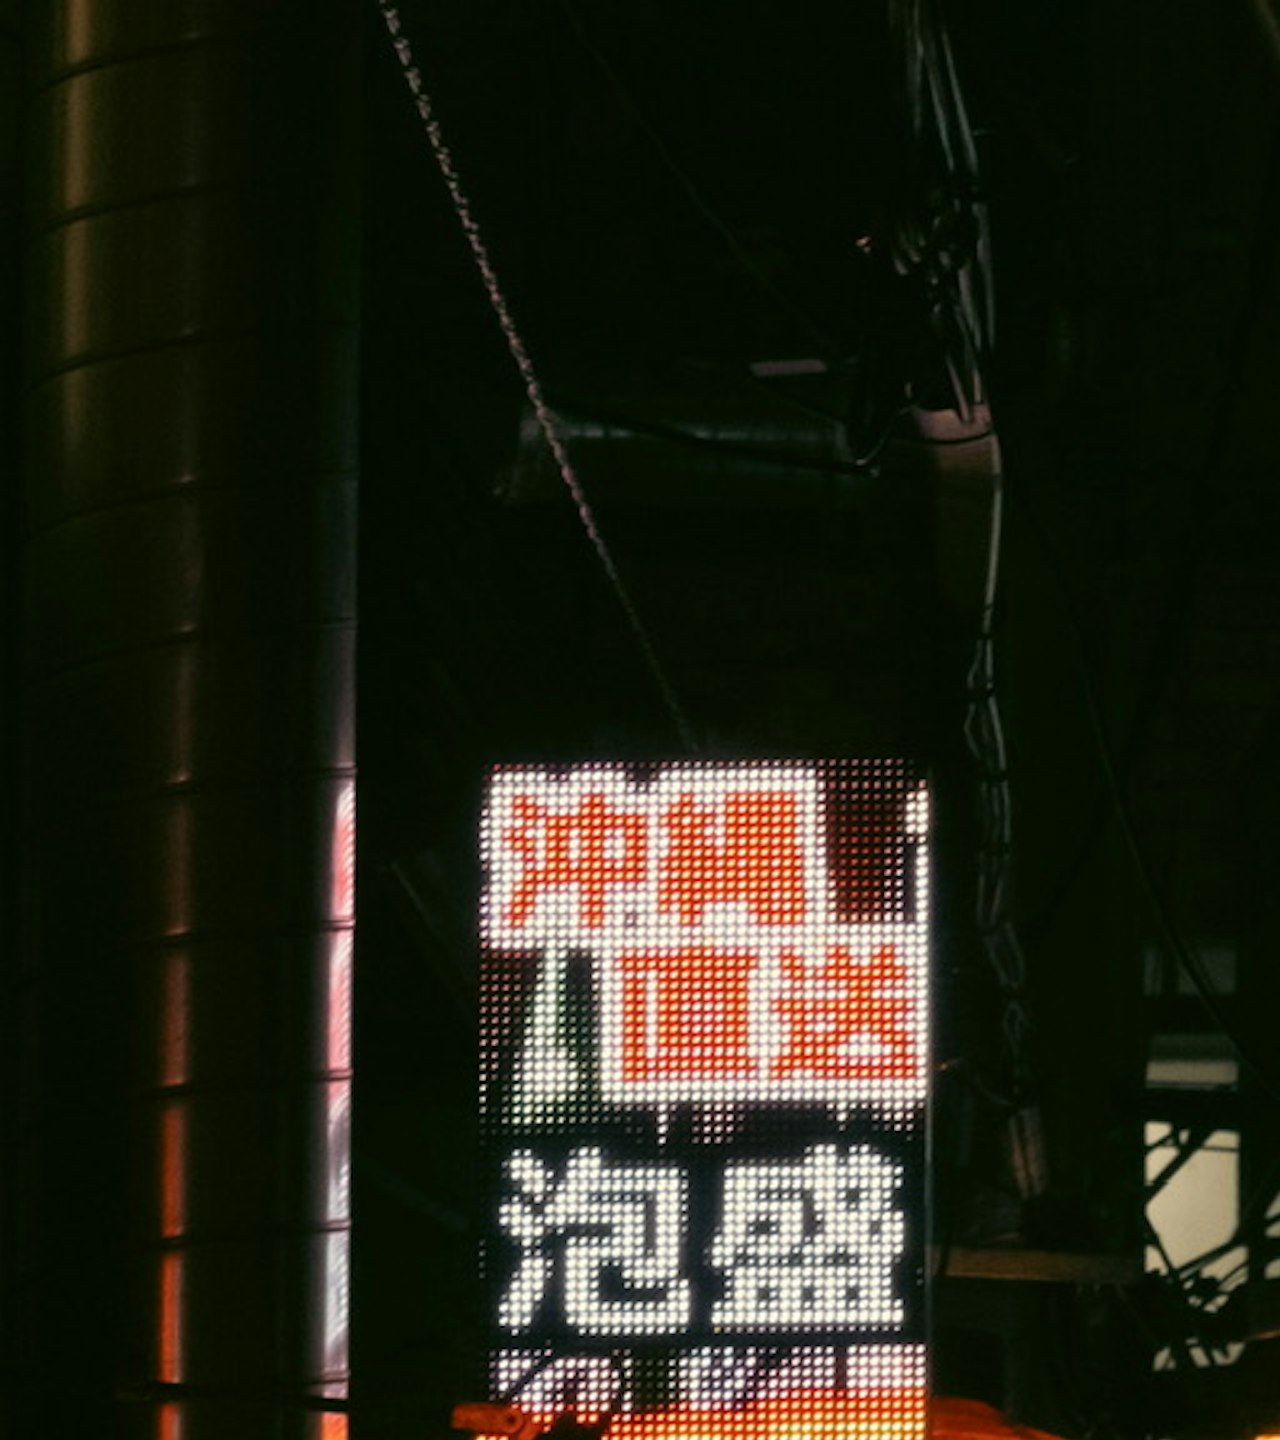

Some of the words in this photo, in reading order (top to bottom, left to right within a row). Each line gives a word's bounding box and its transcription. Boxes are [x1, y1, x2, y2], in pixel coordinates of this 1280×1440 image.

[498, 782, 816, 936] 沖縄
[613, 940, 926, 1088] 直送
[498, 1142, 908, 1336] 泡盛
